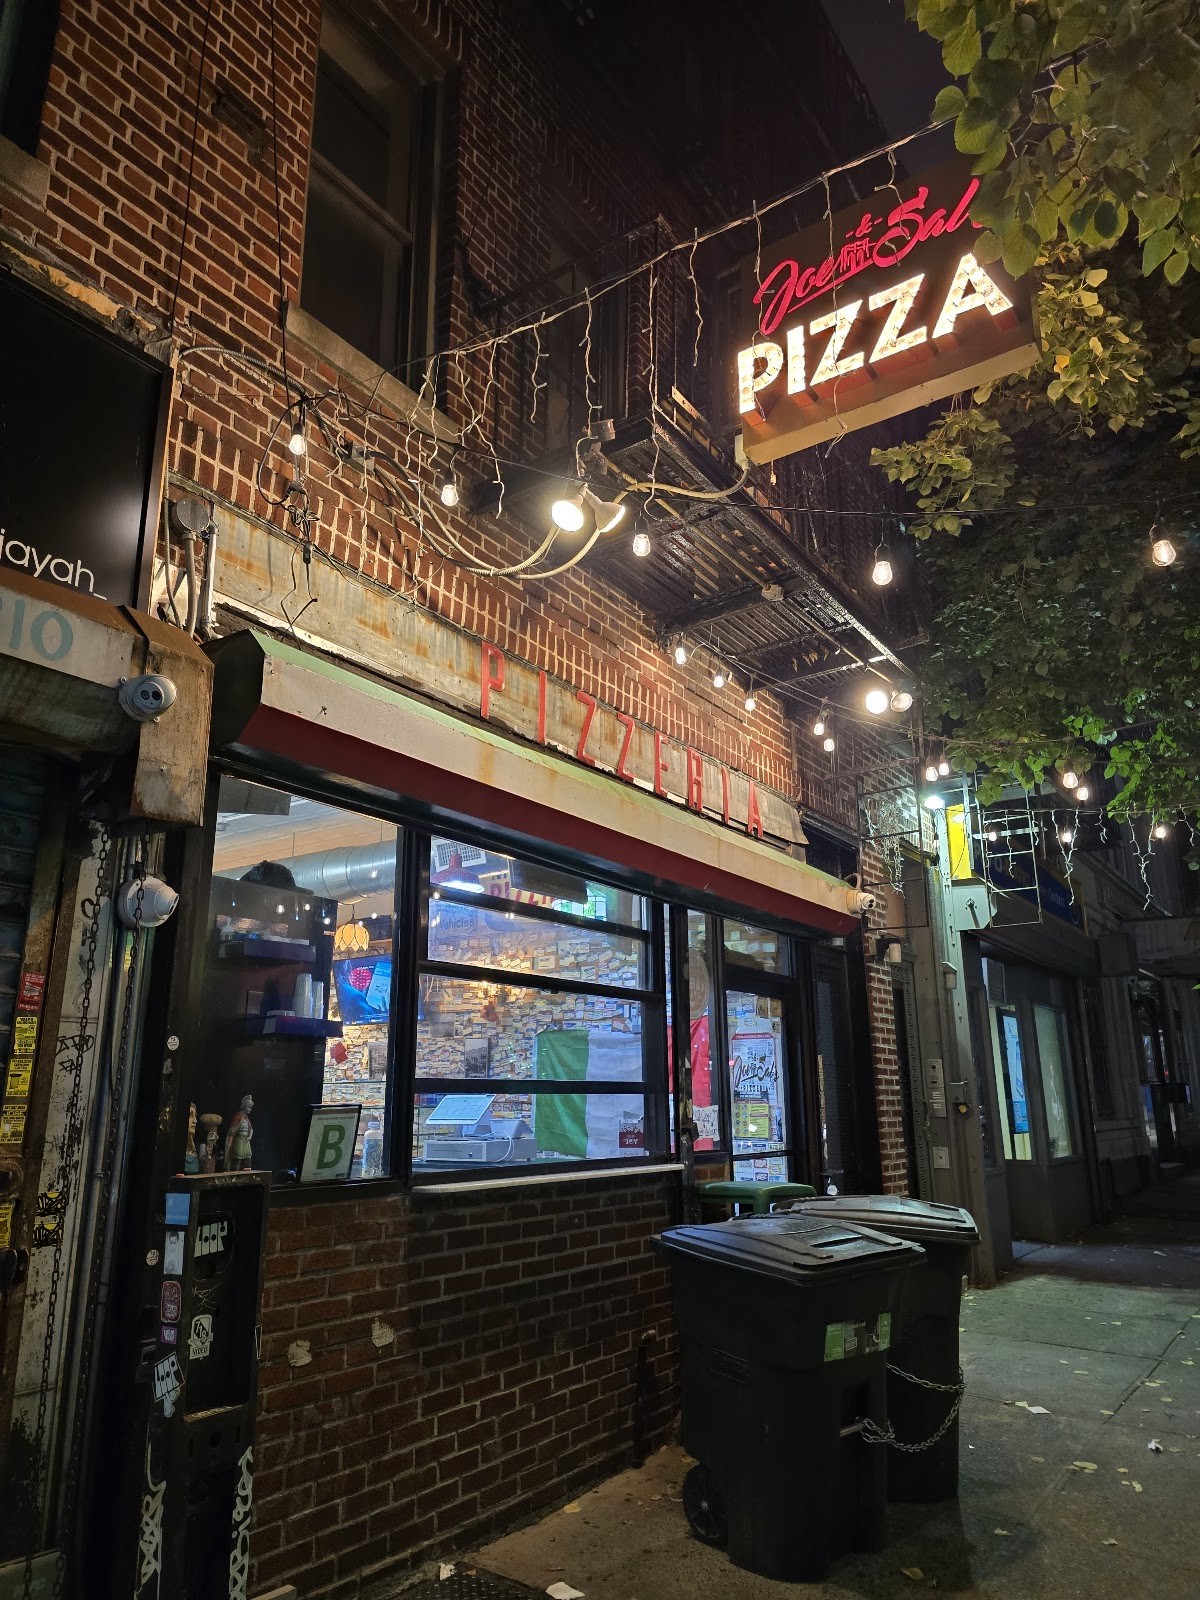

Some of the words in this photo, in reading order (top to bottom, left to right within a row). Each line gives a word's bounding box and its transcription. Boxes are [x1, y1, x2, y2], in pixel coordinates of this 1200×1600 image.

[737, 253, 1014, 414] PIZZA
[753, 256, 834, 335] Joe
[872, 178, 983, 268] Sal
[480, 640, 764, 839] PIZZERIA
[316, 1125, 346, 1170] B
